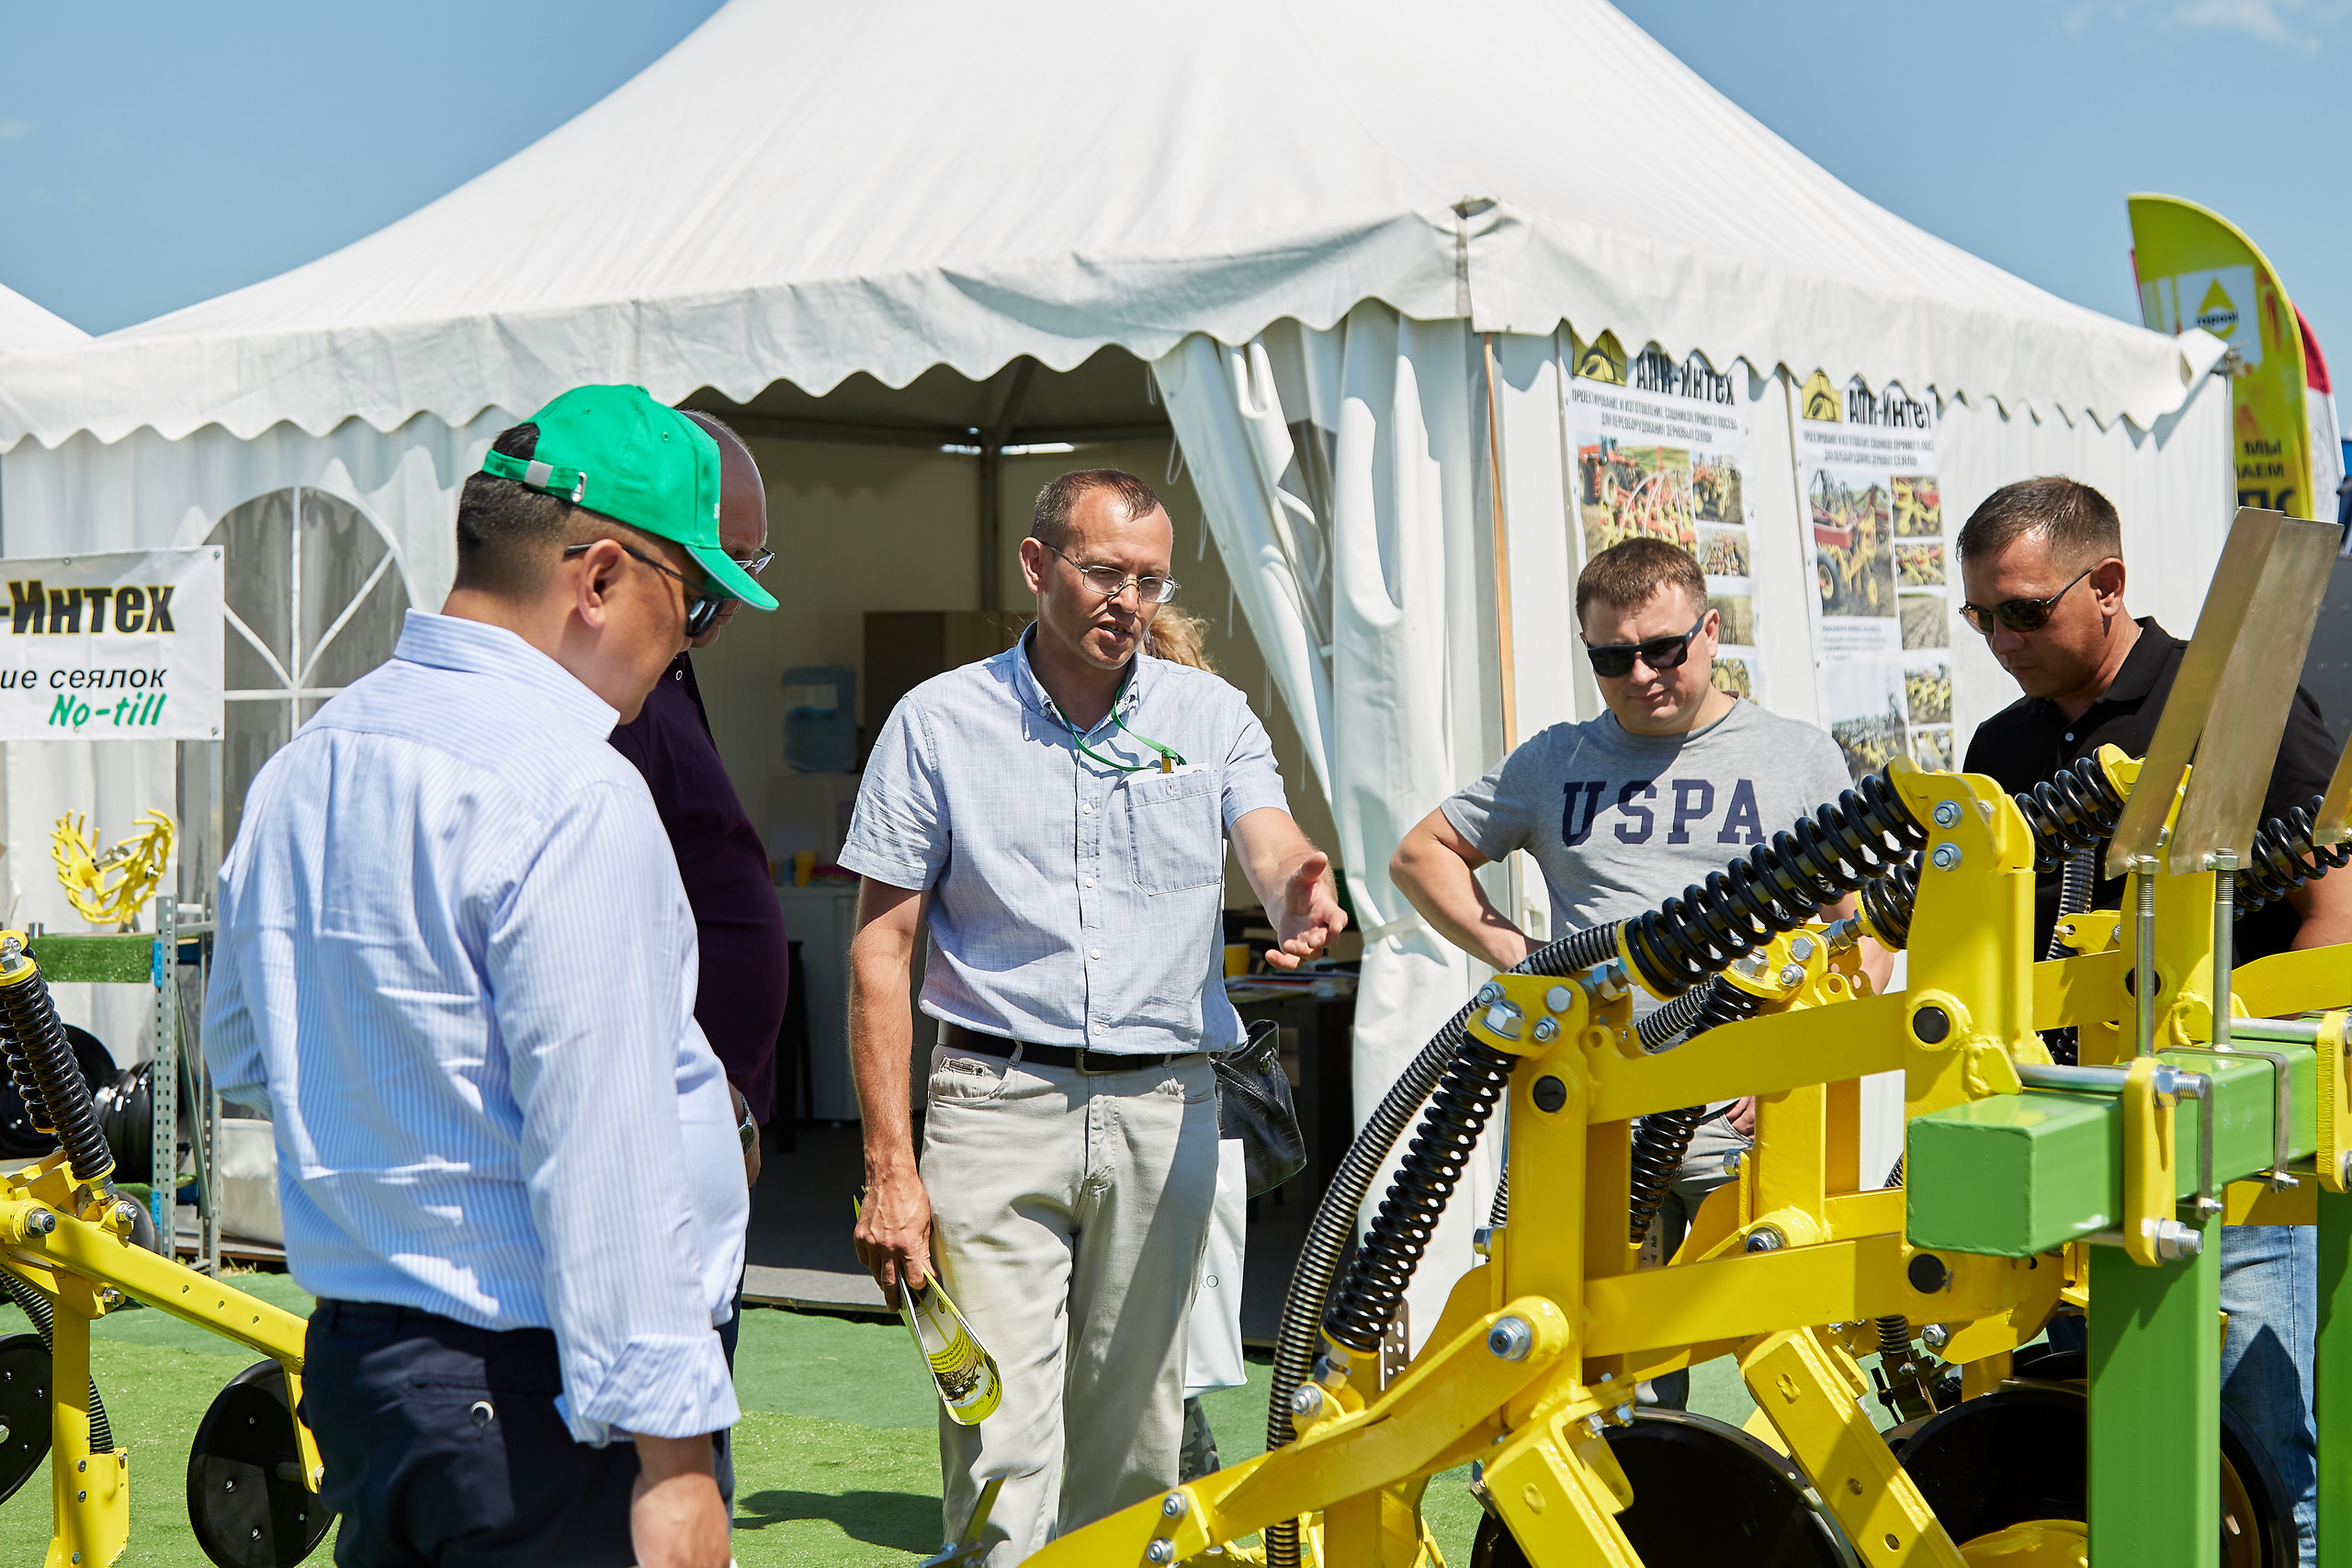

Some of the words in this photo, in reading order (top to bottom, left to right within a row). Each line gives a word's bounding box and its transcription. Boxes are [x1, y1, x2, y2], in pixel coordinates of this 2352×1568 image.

[2245, 439, 2282, 456] МЫ
[50, 668, 167, 689] сеялок
[49, 692, 167, 727] No-till
[1562, 779, 1767, 847] USPA
